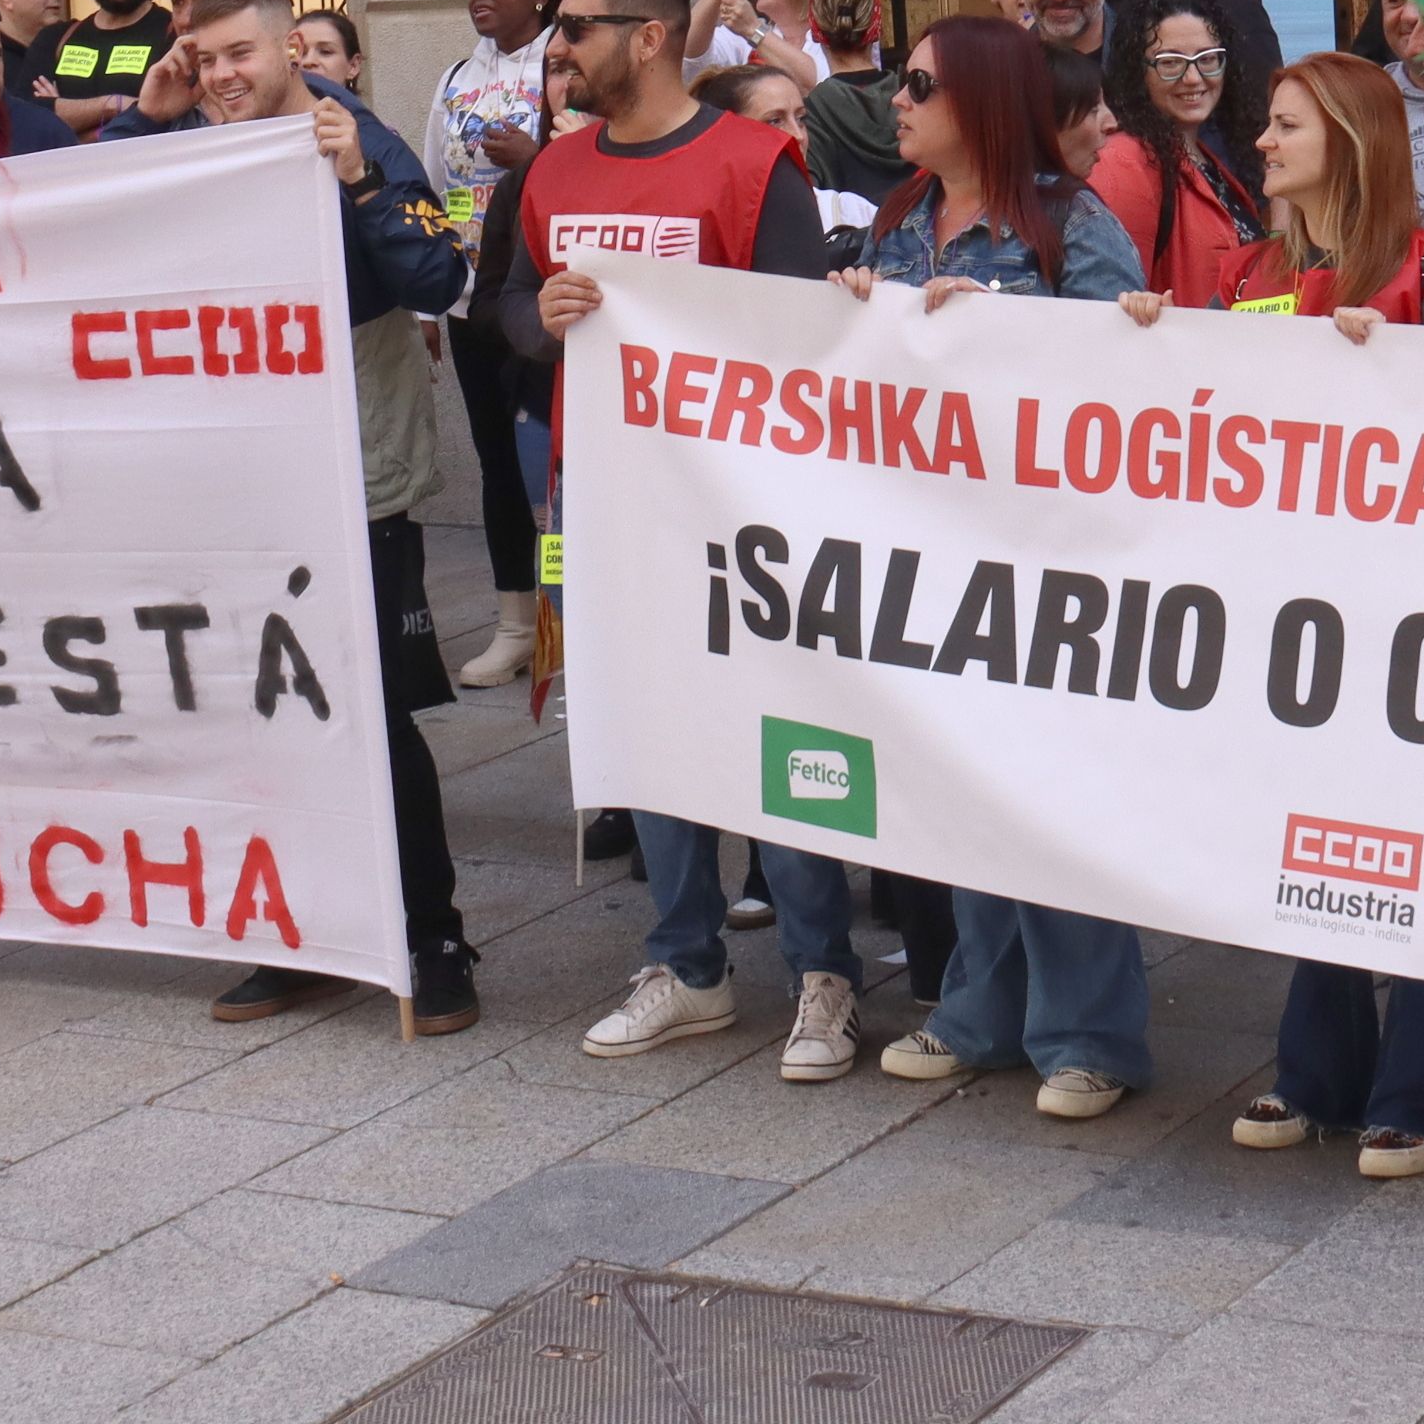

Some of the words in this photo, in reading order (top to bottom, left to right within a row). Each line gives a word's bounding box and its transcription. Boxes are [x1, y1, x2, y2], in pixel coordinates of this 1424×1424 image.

[73, 305, 323, 379] CCOO
[620, 343, 986, 481] BERSHKA
[706, 523, 1227, 712] ¡SALARIO
[1267, 598, 1345, 728] O
[790, 756, 849, 788] Fetico
[1292, 825, 1414, 878] CCOO
[1275, 909, 1317, 927] bershka
[1375, 927, 1412, 944] inditex
[1276, 874, 1415, 928] industria
